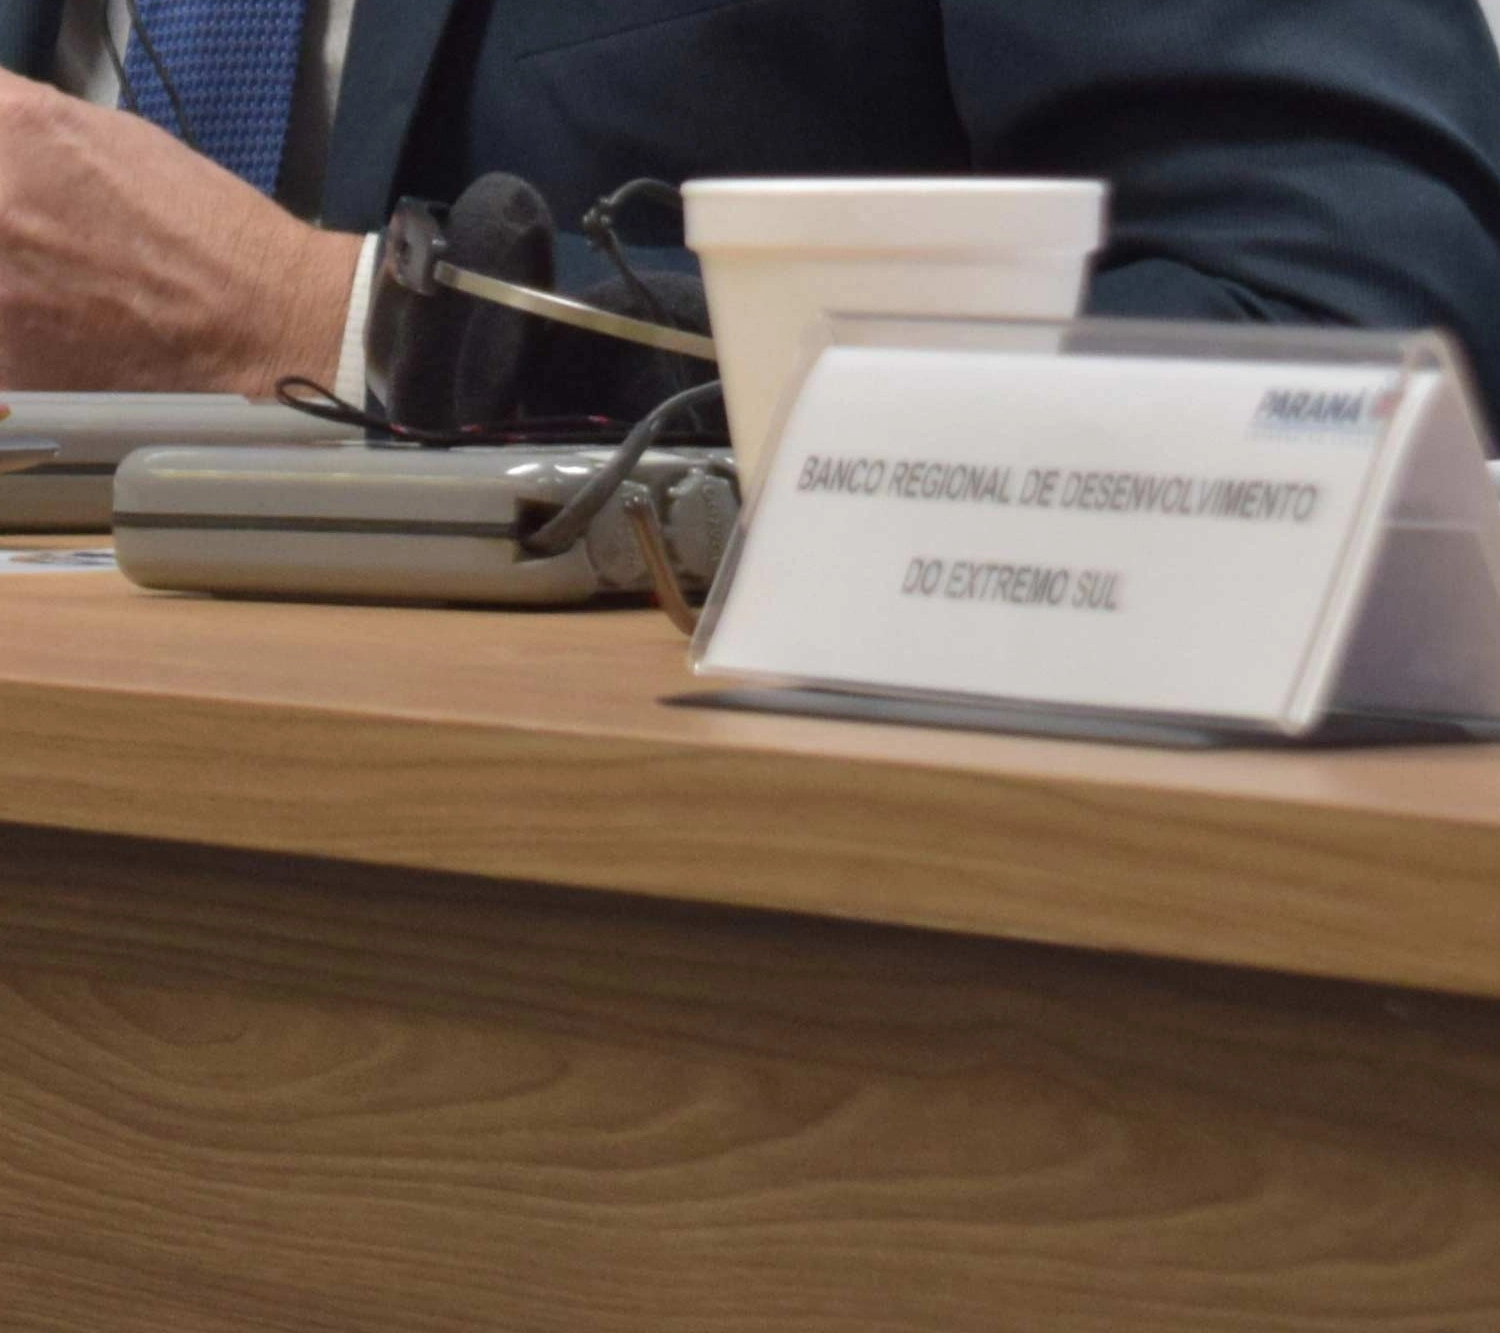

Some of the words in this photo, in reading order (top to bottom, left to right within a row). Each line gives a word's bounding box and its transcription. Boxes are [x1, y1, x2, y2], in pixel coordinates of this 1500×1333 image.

[798, 456, 885, 496] BANCO
[889, 460, 1011, 504] REGIONAL
[1019, 469, 1060, 507] DE
[1060, 471, 1319, 523] DESENVOLVIMENTO
[903, 558, 943, 596] DO
[944, 560, 1070, 606] EXTREMO
[1072, 571, 1120, 611] SUL
